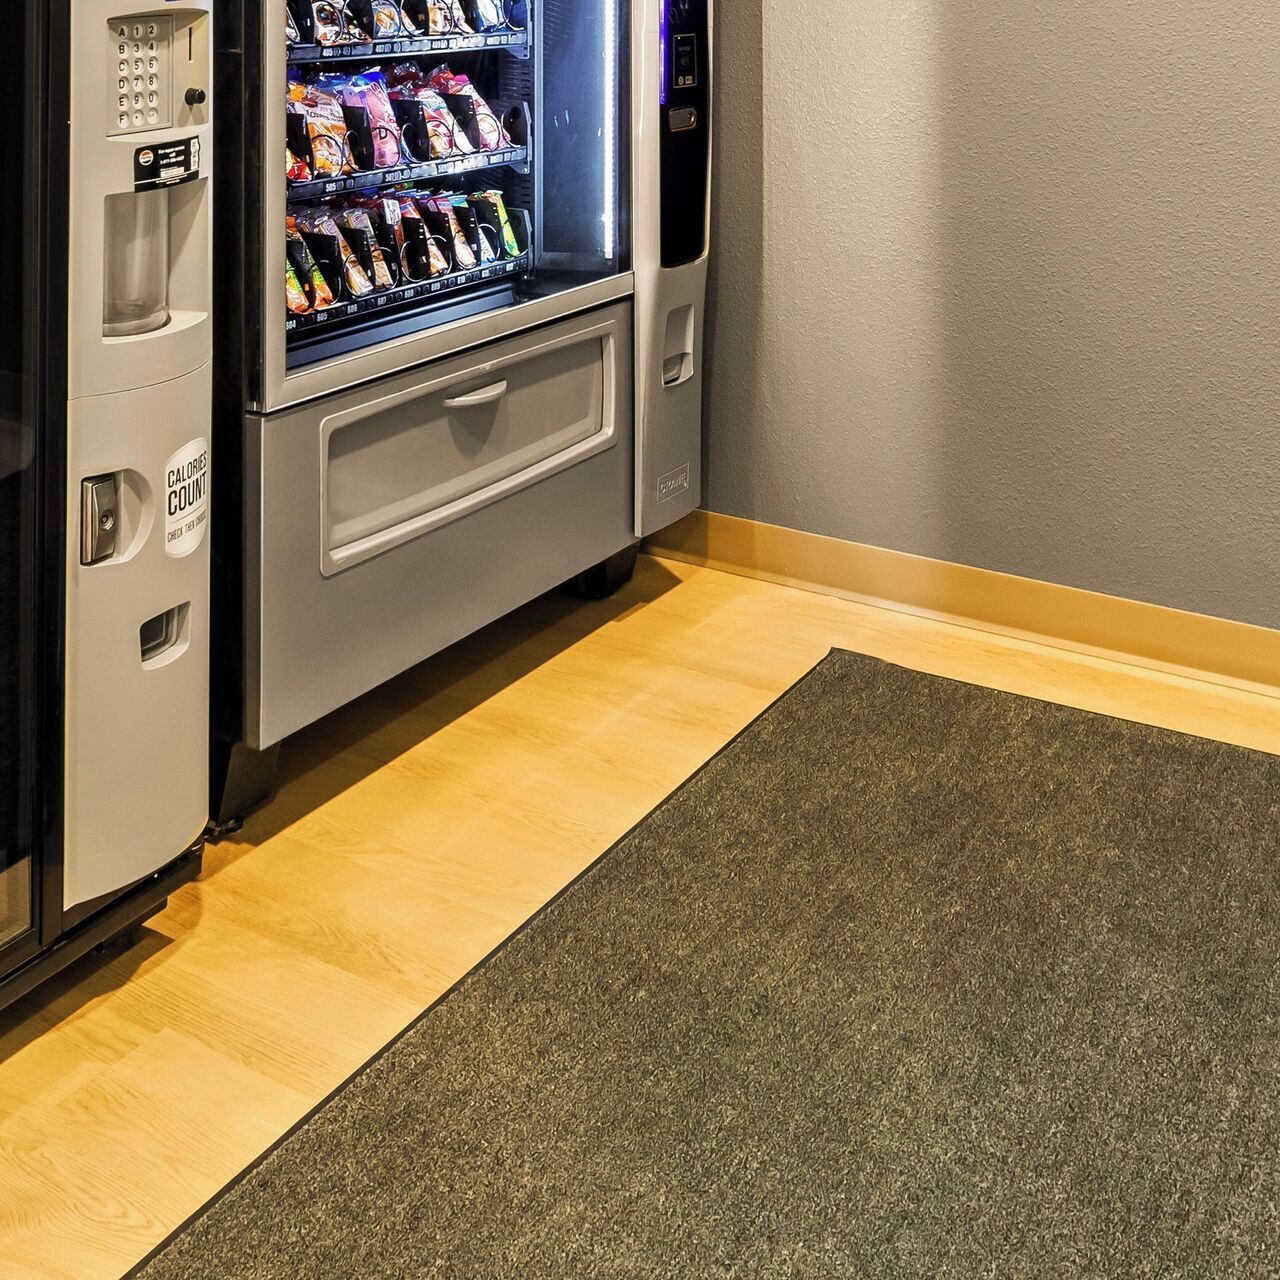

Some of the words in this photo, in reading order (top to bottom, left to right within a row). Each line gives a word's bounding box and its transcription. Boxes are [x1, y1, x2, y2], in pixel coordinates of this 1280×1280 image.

[119, 28, 125, 37] A
[135, 27, 139, 35] 1
[148, 25, 154, 34] 2
[119, 45, 125, 54] B
[134, 44, 139, 52] 3
[148, 42, 154, 50] 4
[119, 62, 125, 71] C
[134, 61, 139, 70] 5
[149, 60, 153, 69] 6
[119, 80, 125, 89] D
[134, 78, 139, 87] 7
[149, 77, 153, 85] 8
[119, 97, 125, 106] E
[134, 95, 139, 104] 9
[149, 93, 153, 102] 0
[119, 114, 125, 124] F
[167, 450, 207, 488] CALORIES
[168, 470, 207, 516] COUNT
[167, 526, 184, 543] CHECK
